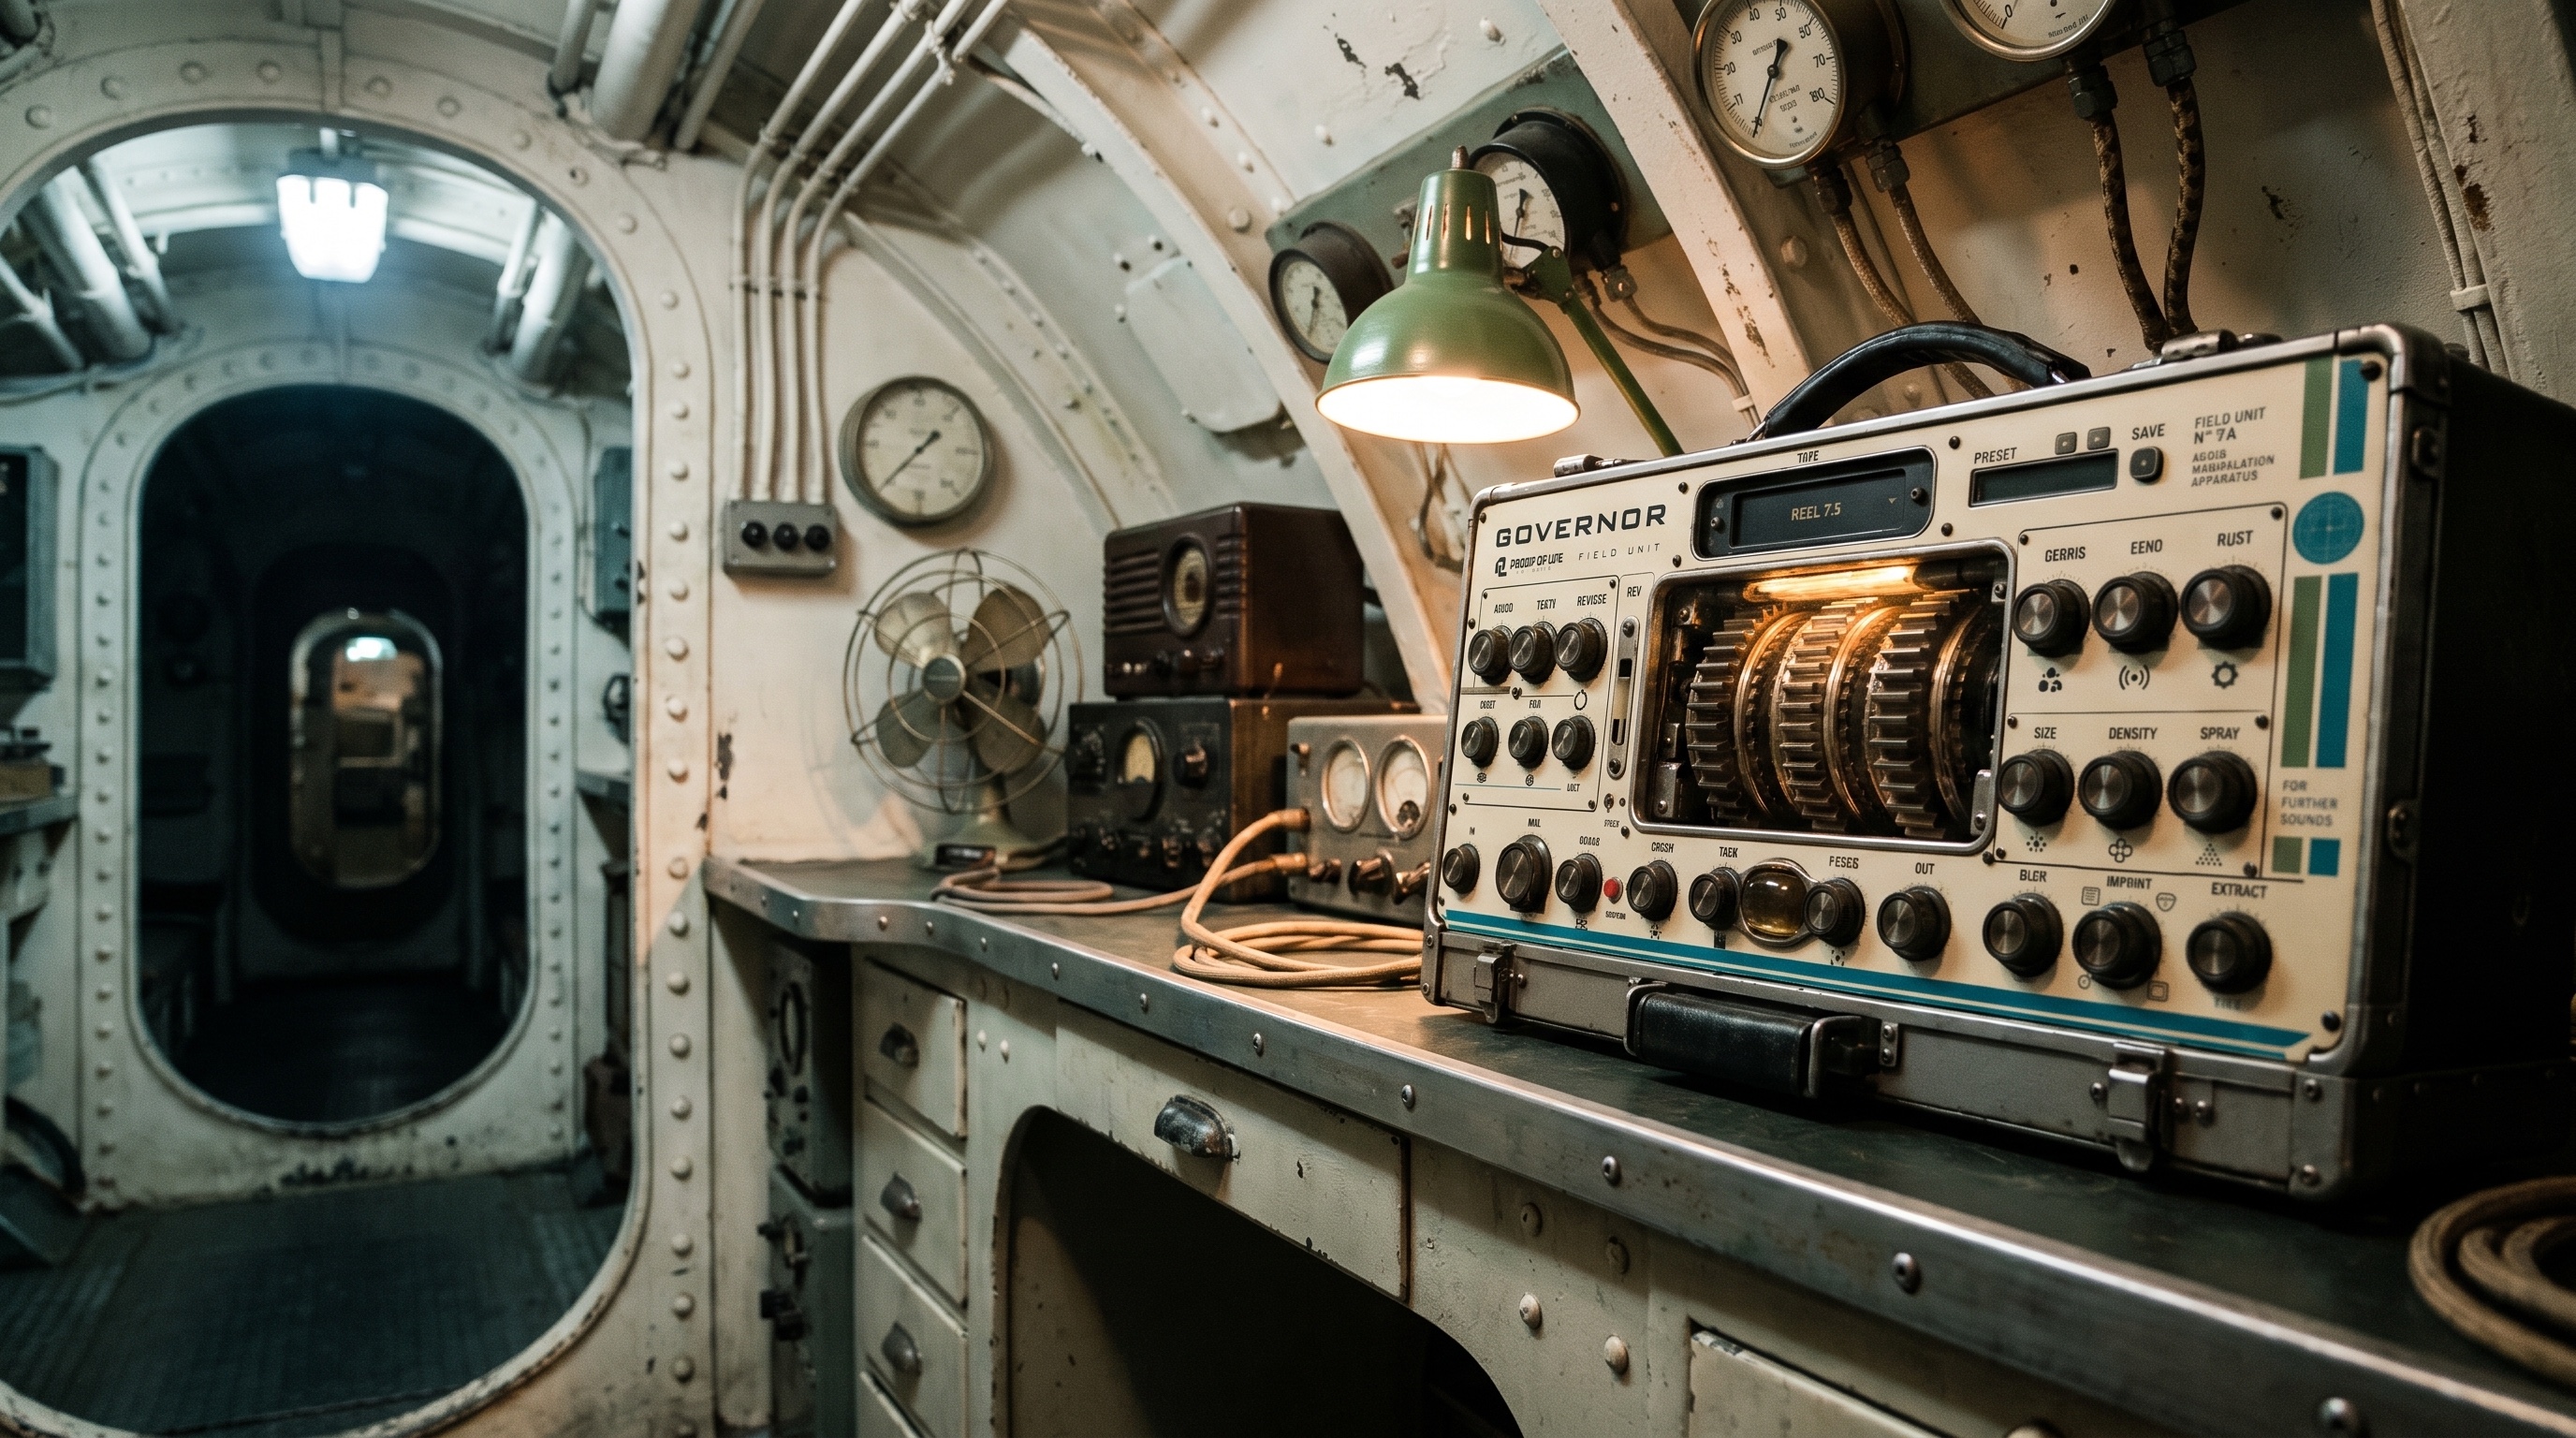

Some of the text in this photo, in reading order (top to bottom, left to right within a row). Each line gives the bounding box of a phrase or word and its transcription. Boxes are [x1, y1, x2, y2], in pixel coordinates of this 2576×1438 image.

[1749, 7, 1761, 22] 40
[1812, 53, 1826, 68] 70
[2194, 405, 2266, 429] FIELD UNIT
[2131, 423, 2166, 441] SAVE
[1796, 450, 1820, 463] TAPE
[1973, 447, 2018, 464] PRESET
[2191, 470, 2259, 487] APPARATUS
[1791, 502, 1842, 521] REEL 7.5
[1496, 504, 1666, 548] GOVERNOR
[2217, 530, 2254, 547] RUST
[1578, 543, 1661, 561] FIELD UNIT
[2044, 546, 2086, 562] GERRIS
[1626, 586, 1643, 597] REV
[2034, 726, 2057, 740] SIZE
[2108, 726, 2159, 740] DENSITY
[2200, 726, 2241, 741] SPRAY
[2282, 780, 2307, 792] FOR
[2280, 813, 2334, 827] SOUNDS
[1914, 861, 1936, 875] OUT
[2210, 882, 2268, 899] EXTRACT
